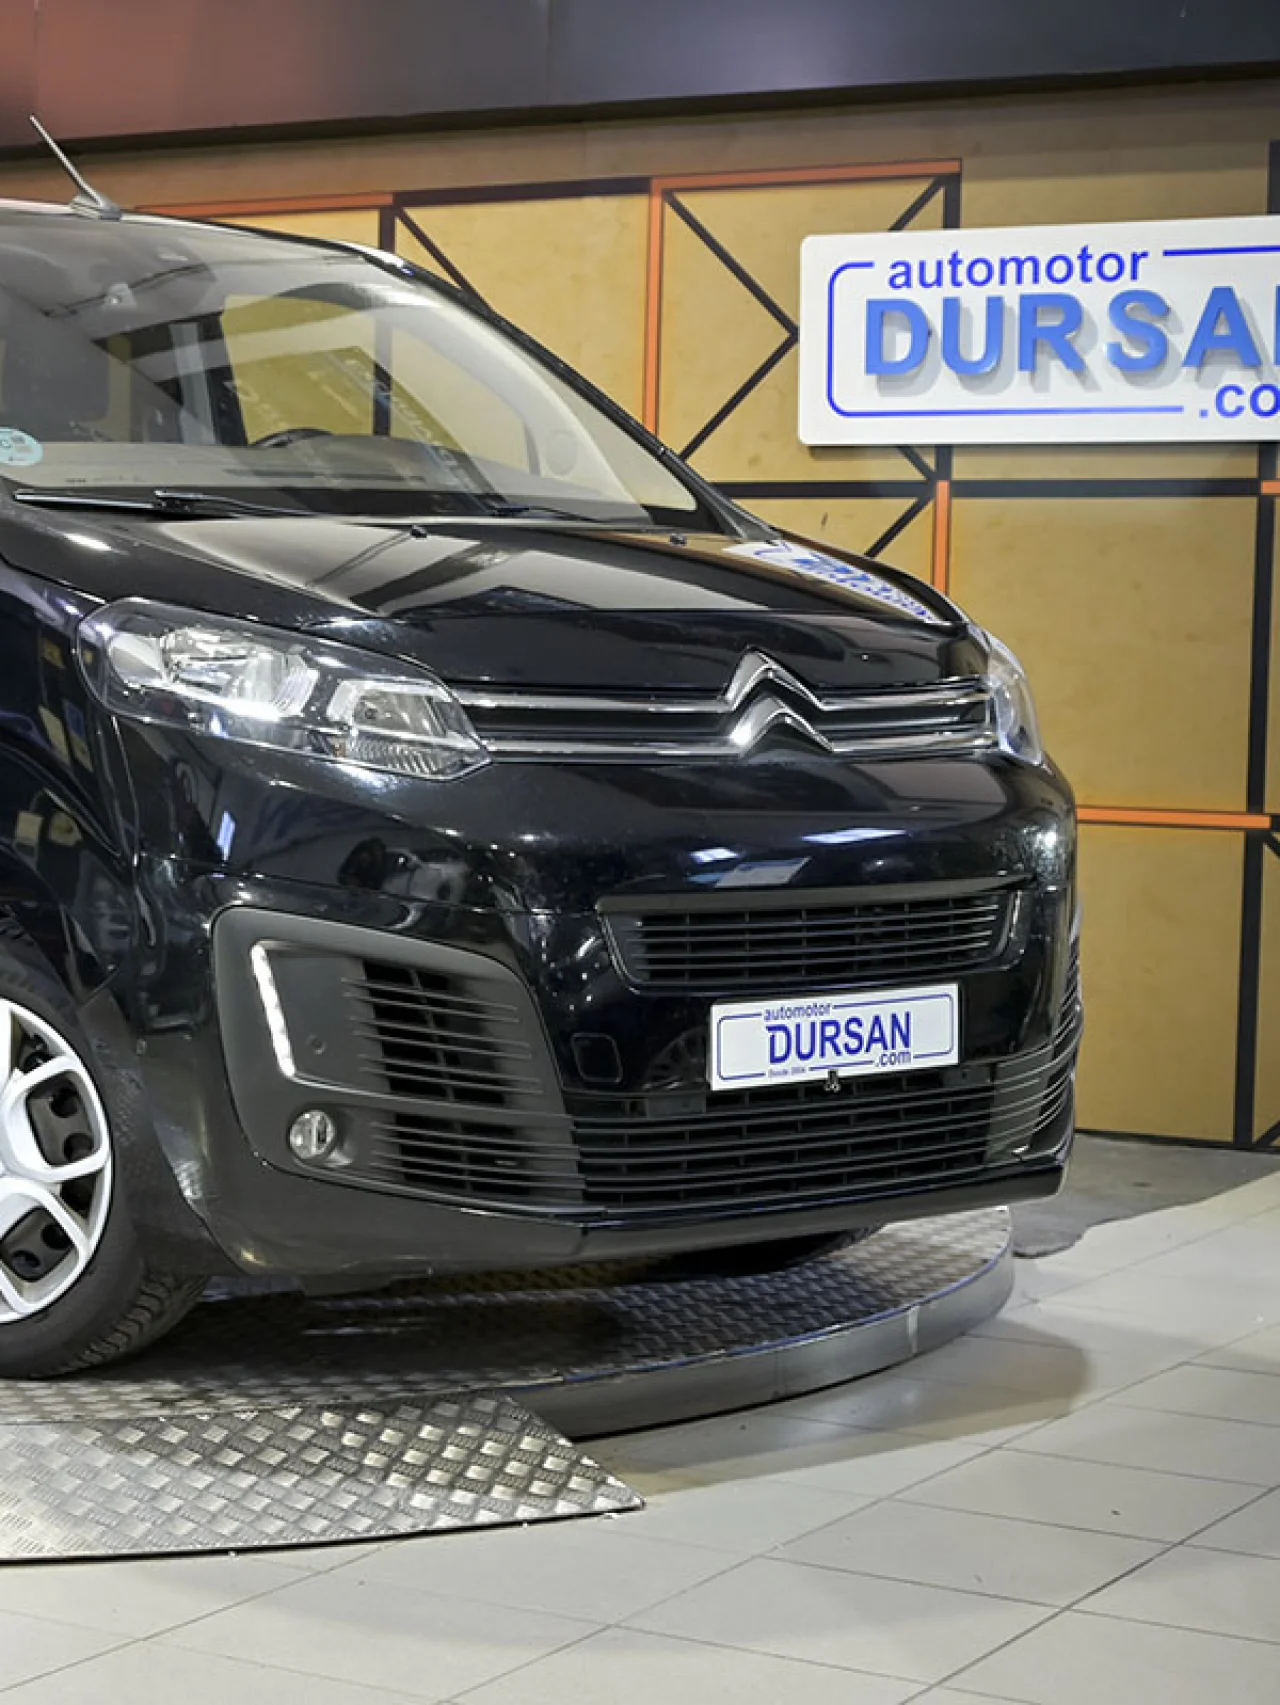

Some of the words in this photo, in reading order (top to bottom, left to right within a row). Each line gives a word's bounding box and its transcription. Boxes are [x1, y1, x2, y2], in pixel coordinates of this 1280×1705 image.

[888, 244, 1149, 289] automotor
[865, 285, 1280, 376] DURSA
[763, 1002, 832, 1021] automotor
[766, 1011, 912, 1064] DURSAN
[874, 1050, 912, 1067] .com
